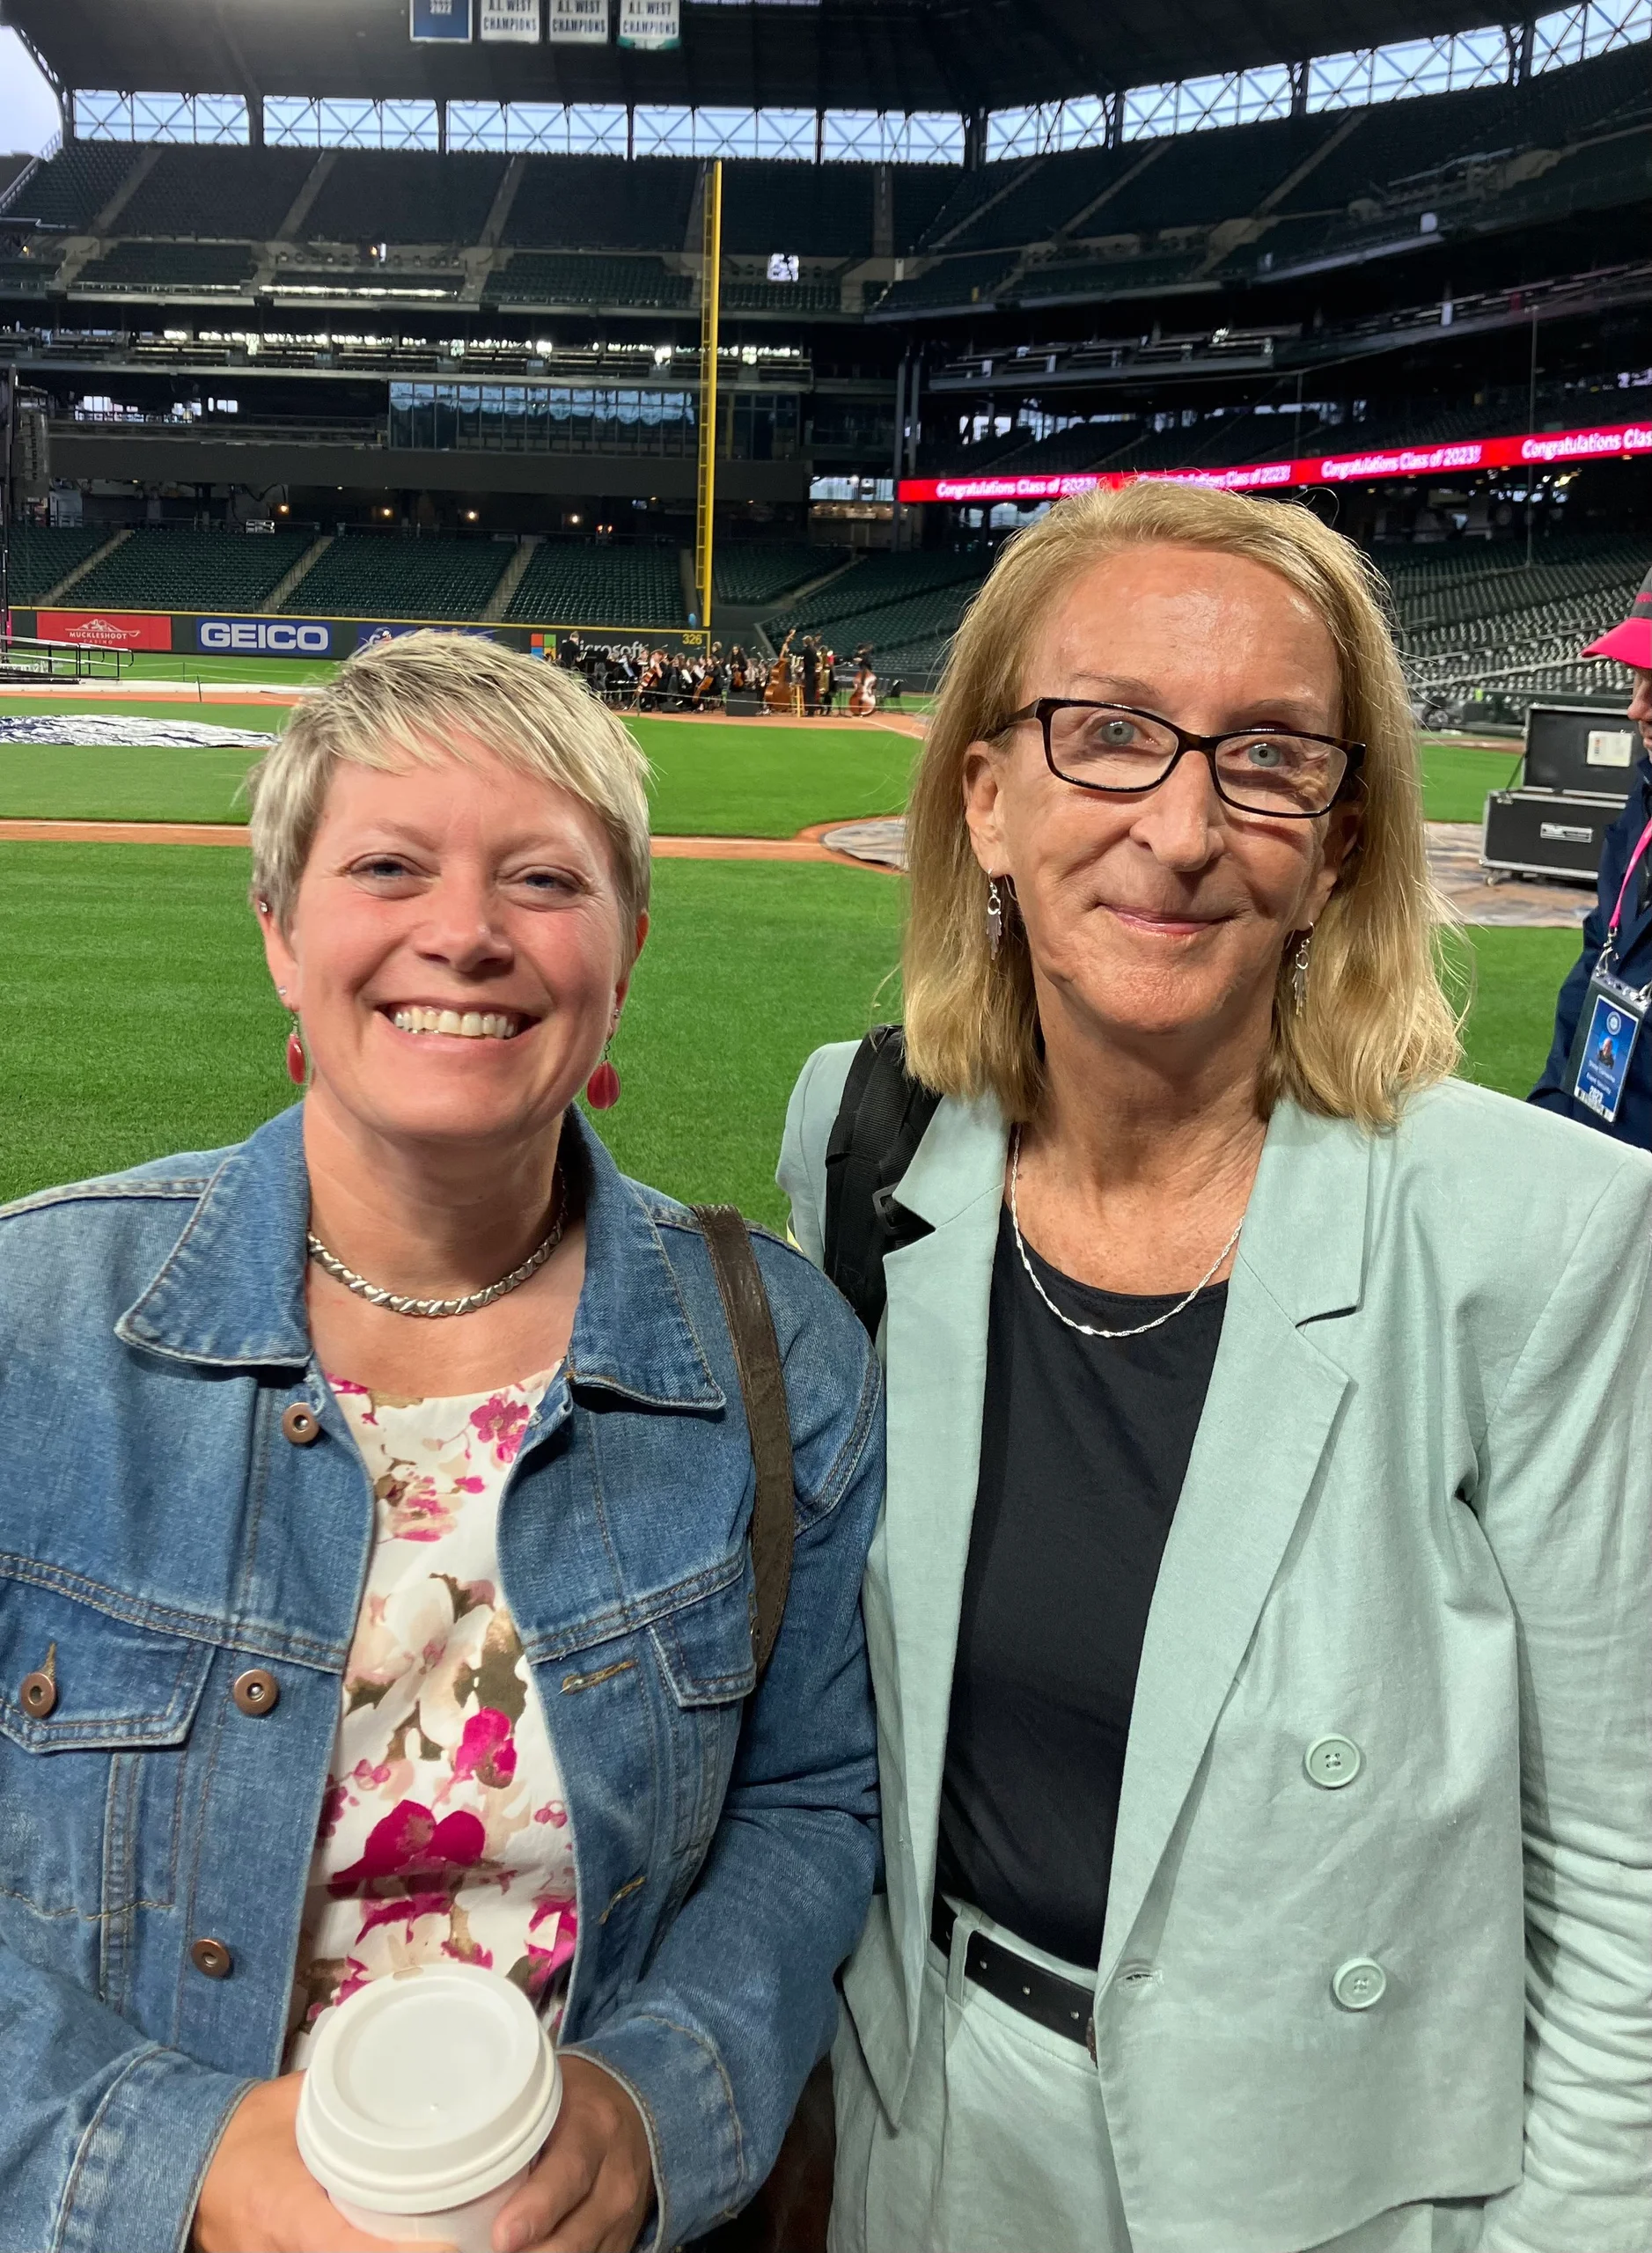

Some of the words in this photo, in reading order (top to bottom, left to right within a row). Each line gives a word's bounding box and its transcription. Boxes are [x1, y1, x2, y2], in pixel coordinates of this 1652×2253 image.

[507, 0, 532, 11] WEST
[576, 1, 600, 13] WEST
[646, 2, 672, 16] WEST
[483, 17, 537, 32] CHAMPIONS
[552, 18, 606, 33] CHAMPIONS
[622, 19, 677, 35] CHAMPIONS
[1521, 433, 1622, 460] Congratulations
[1321, 454, 1399, 480] Congratulations
[1399, 451, 1429, 470] Class
[1429, 448, 1445, 467] of
[1443, 444, 1483, 466] 2023!
[936, 481, 1016, 500] Congratulations
[1016, 479, 1046, 495] Class
[1046, 477, 1061, 494] of
[69, 631, 128, 640] MUCKLESHOOT
[201, 622, 329, 651] GEICO
[682, 633, 703, 645] 326
[562, 641, 644, 658] icrosoft
